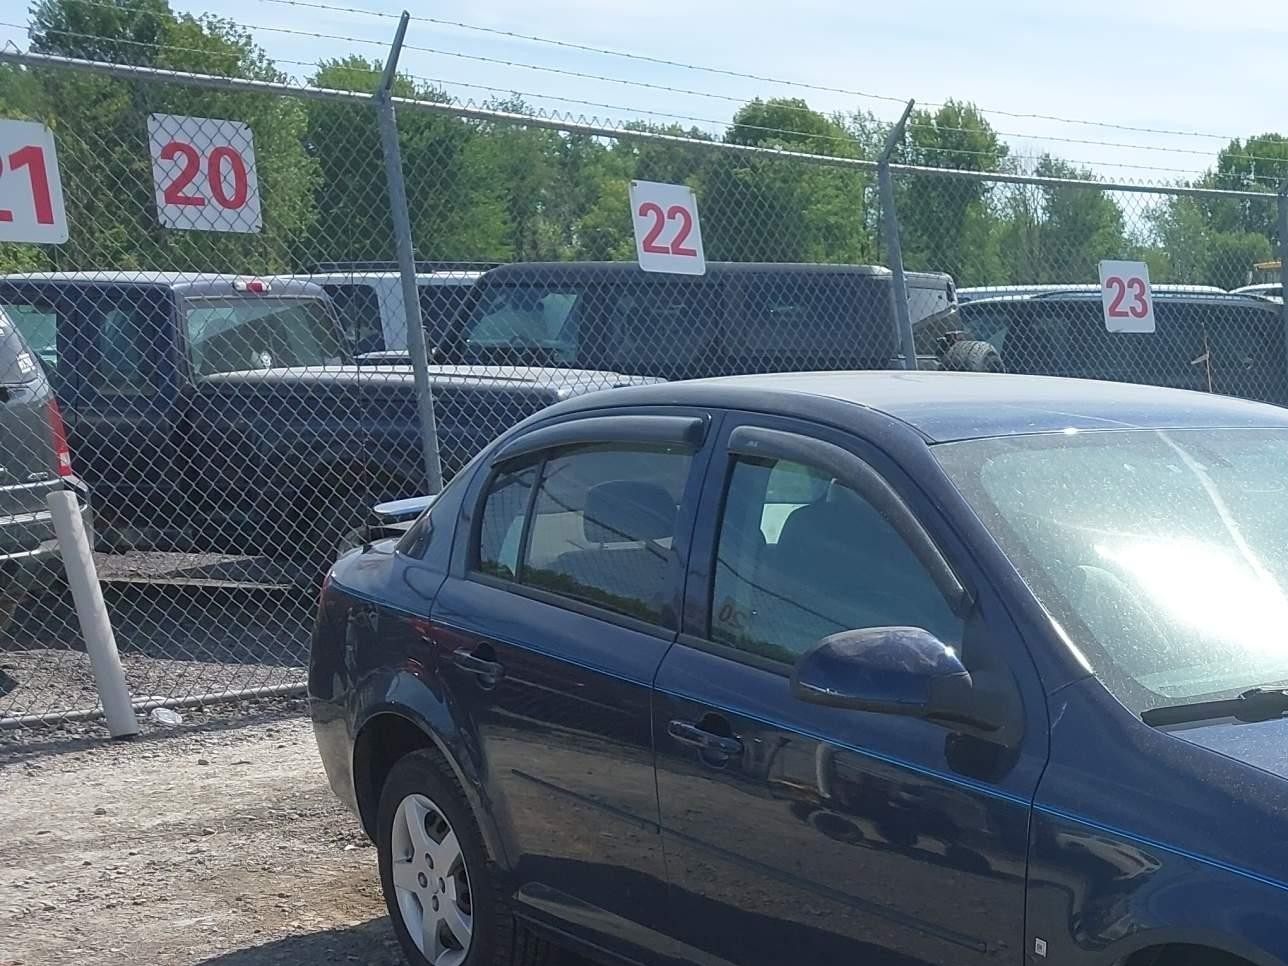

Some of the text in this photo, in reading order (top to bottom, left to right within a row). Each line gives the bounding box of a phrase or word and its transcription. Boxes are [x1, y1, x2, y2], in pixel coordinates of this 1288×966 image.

[161, 141, 248, 210] 20
[639, 203, 697, 256] 22
[1105, 276, 1149, 319] 23
